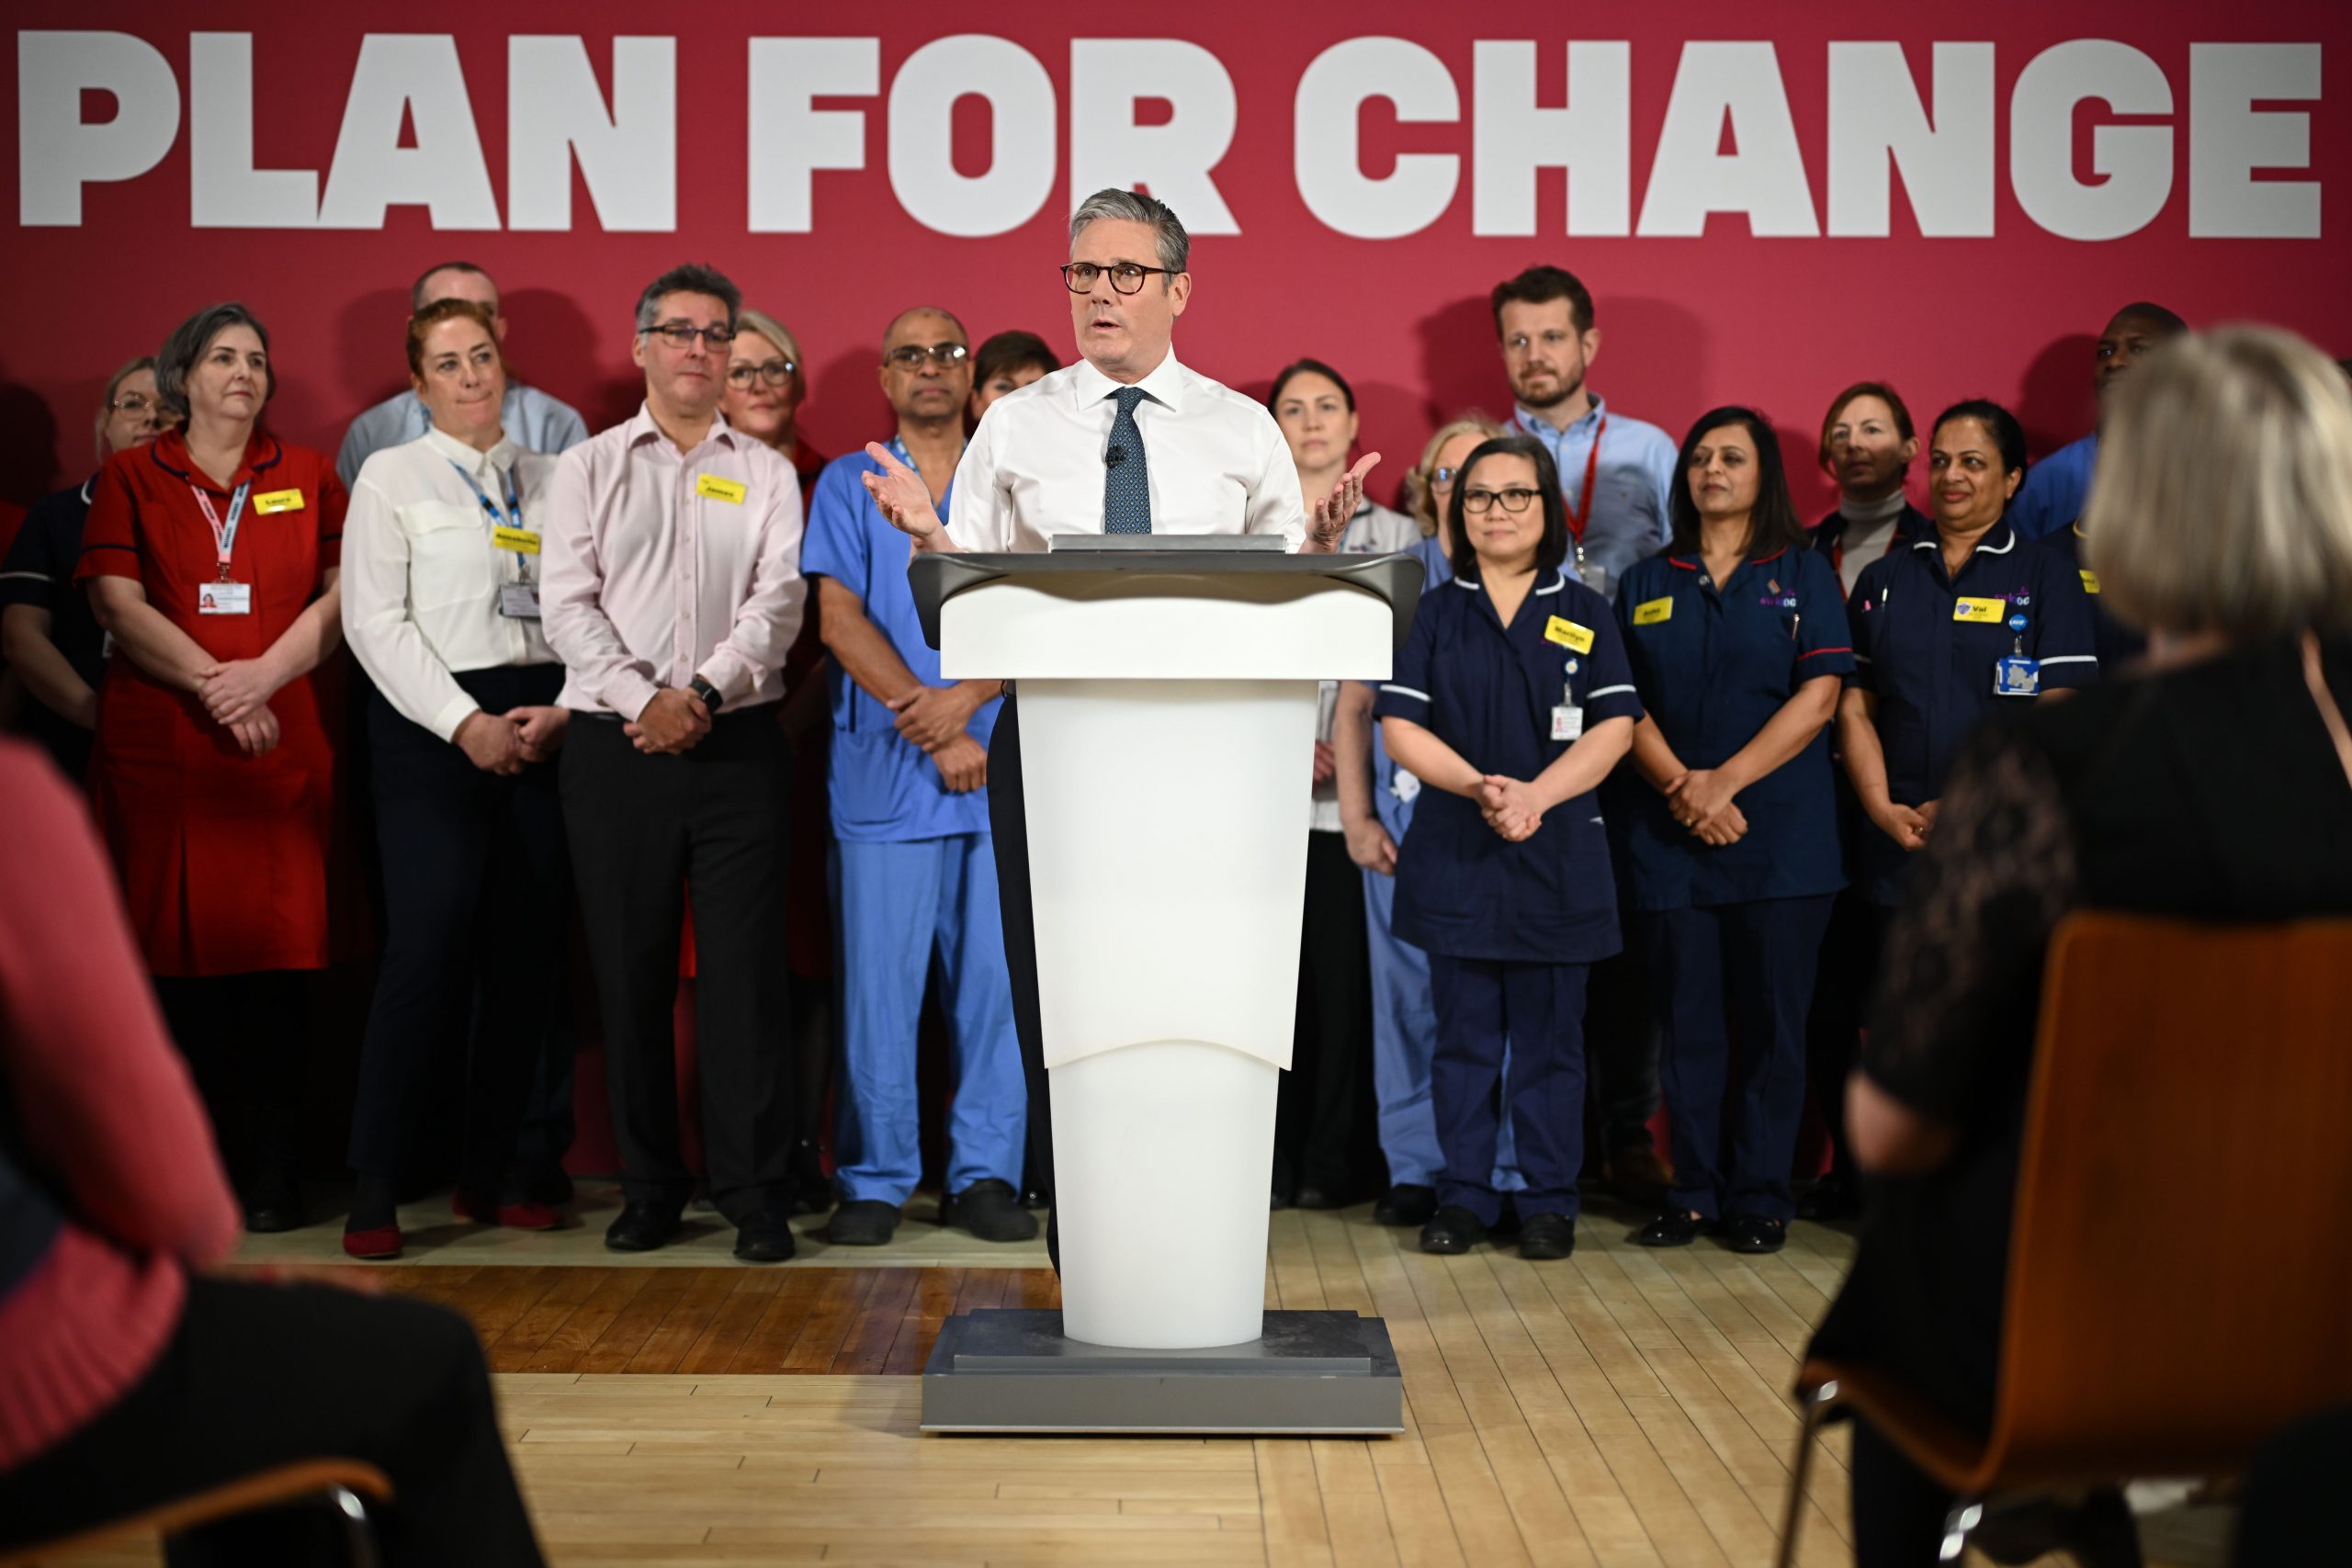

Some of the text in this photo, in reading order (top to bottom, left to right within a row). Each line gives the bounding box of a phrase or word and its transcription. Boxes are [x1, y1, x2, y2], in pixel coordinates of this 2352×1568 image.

[18, 30, 2322, 242] PLAN FOR CHANGE
[1973, 605, 1987, 614] Val
[1555, 626, 1586, 643] Marilyn
